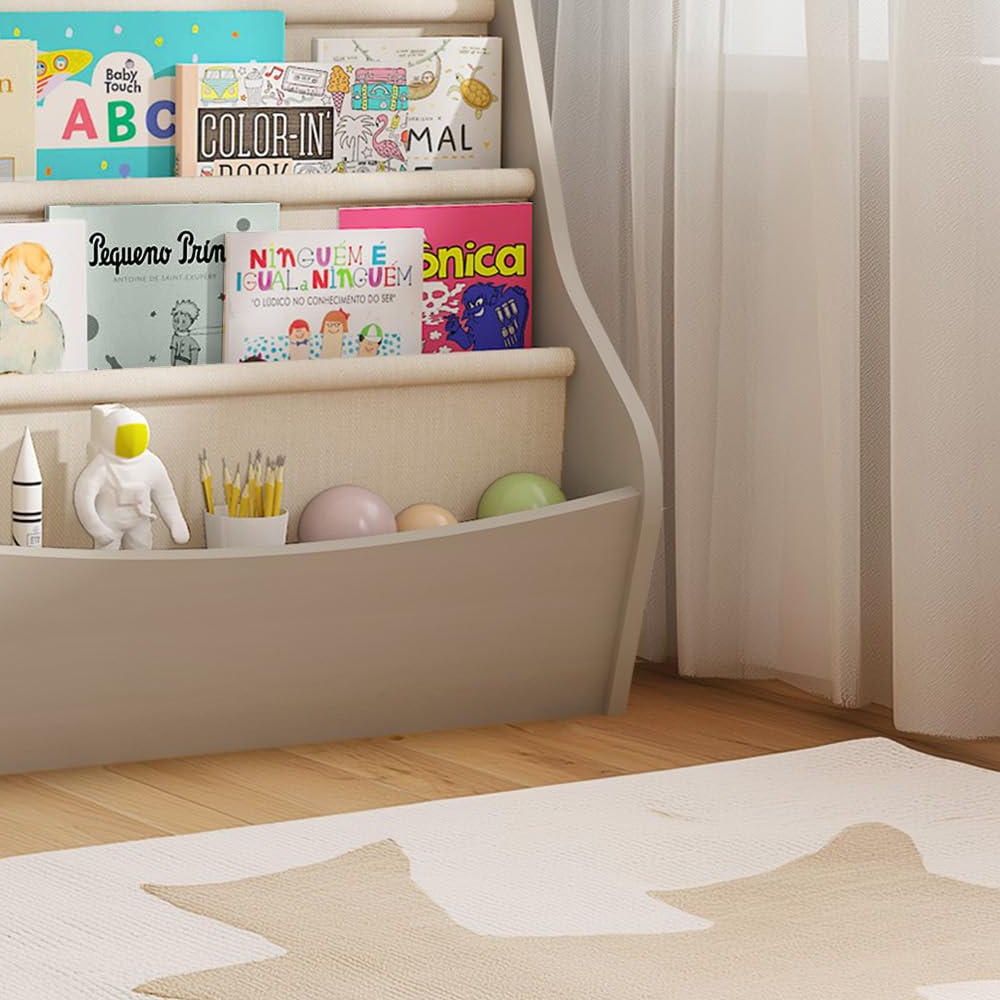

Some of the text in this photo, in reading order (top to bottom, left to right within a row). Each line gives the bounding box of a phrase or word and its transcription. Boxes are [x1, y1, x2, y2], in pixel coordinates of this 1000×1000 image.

[105, 68, 138, 85] Baby
[104, 81, 142, 94] Touch
[88, 232, 173, 275] Pequeno
[423, 241, 526, 280] ônica
[300, 280, 309, 292] a
[290, 297, 304, 307] NO
[306, 295, 366, 306] CONHECIMENTO
[368, 294, 380, 304] DO
